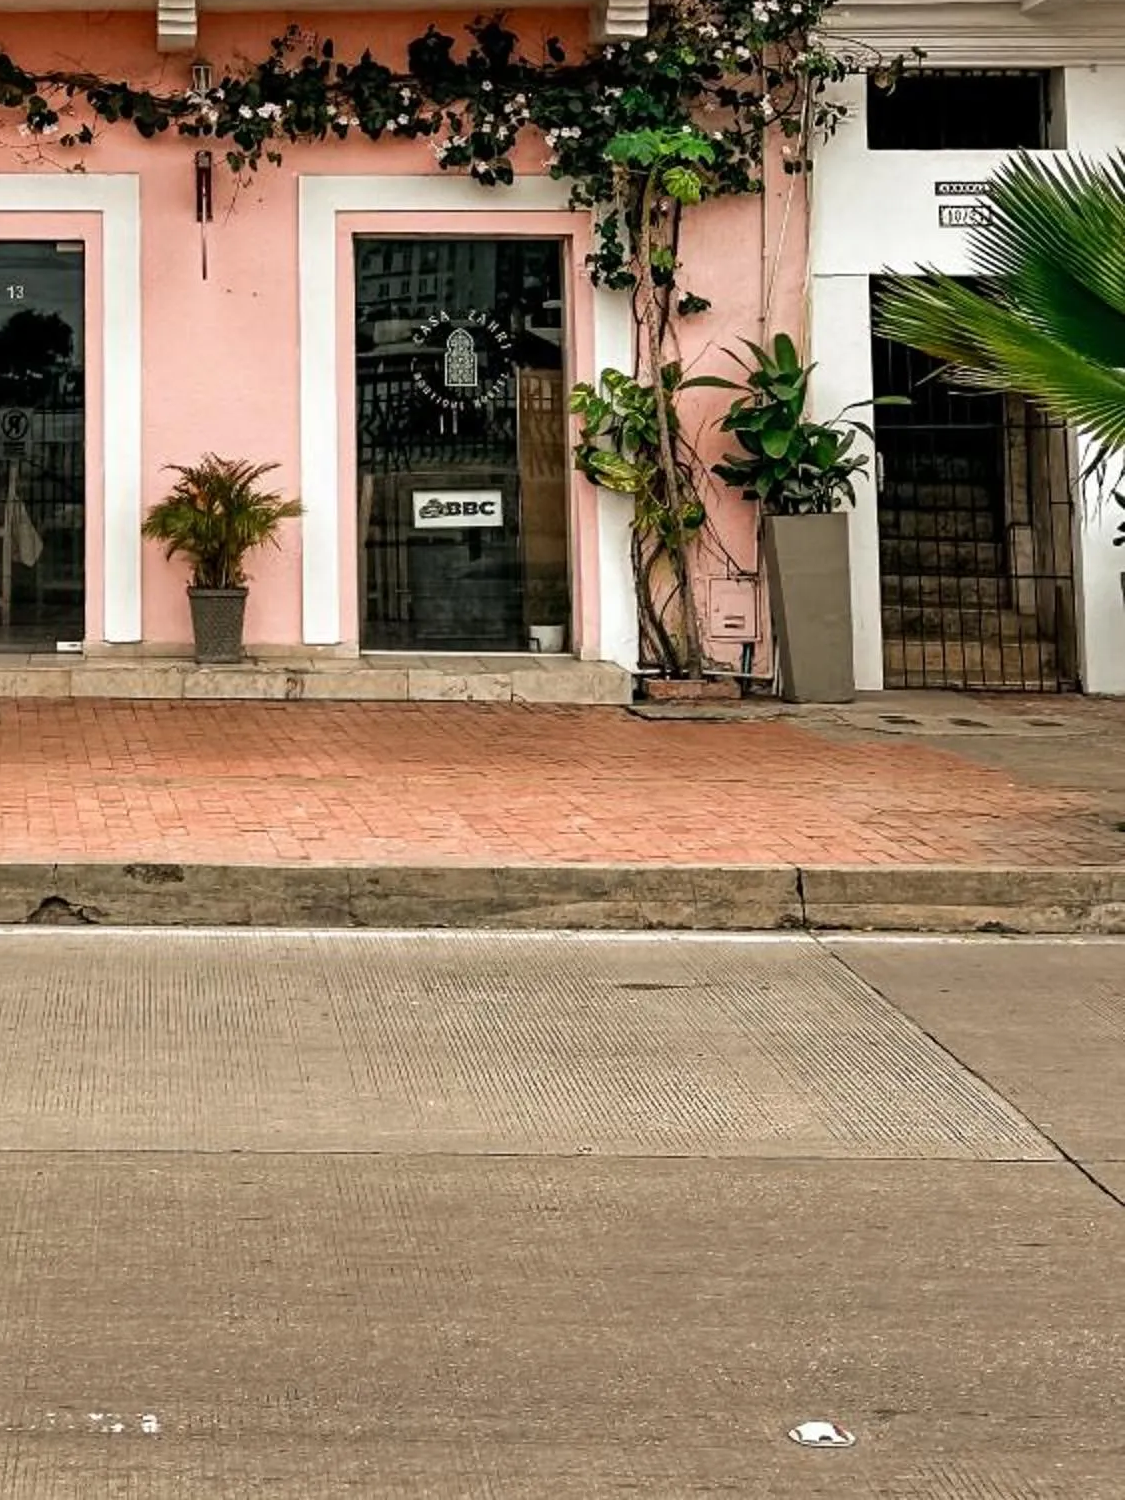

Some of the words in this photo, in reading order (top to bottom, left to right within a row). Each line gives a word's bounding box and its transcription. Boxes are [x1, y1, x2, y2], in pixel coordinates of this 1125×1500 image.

[6, 285, 24, 299] 13
[413, 310, 450, 344] CASA
[445, 502, 496, 516] BBC
